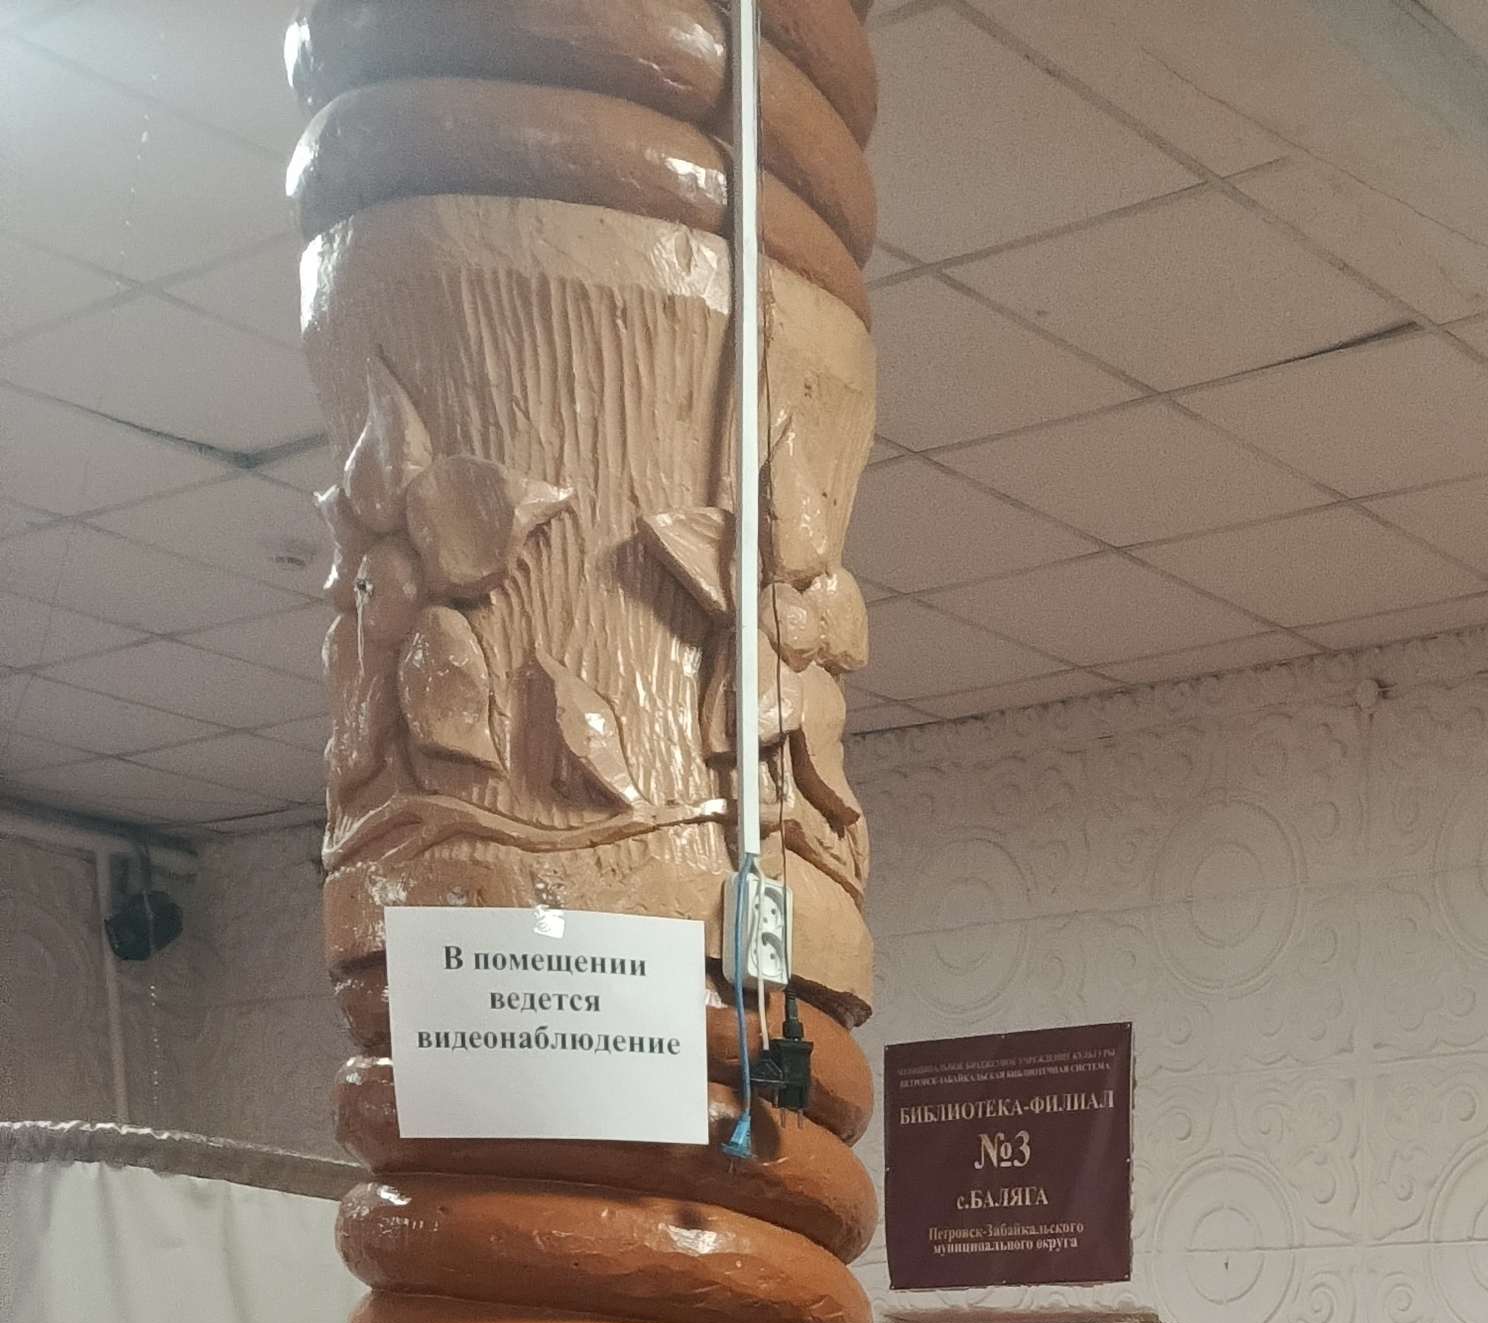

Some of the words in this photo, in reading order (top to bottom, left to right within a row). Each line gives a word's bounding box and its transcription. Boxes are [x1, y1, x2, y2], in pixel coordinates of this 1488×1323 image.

[444, 946, 464, 970] В
[474, 951, 647, 977] помещении
[490, 990, 601, 1012] ведется
[417, 1026, 681, 1055] видеонаблюдение
[900, 1090, 1115, 1125] БИБЛИОТЕКА-ФИЛИАЛ
[974, 1130, 1031, 1170] №3
[956, 1186, 1049, 1210] с.БАЛЯГА
[928, 1222, 1085, 1243] Петровск-Забайкальского
[1036, 1236, 1079, 1253] округа
